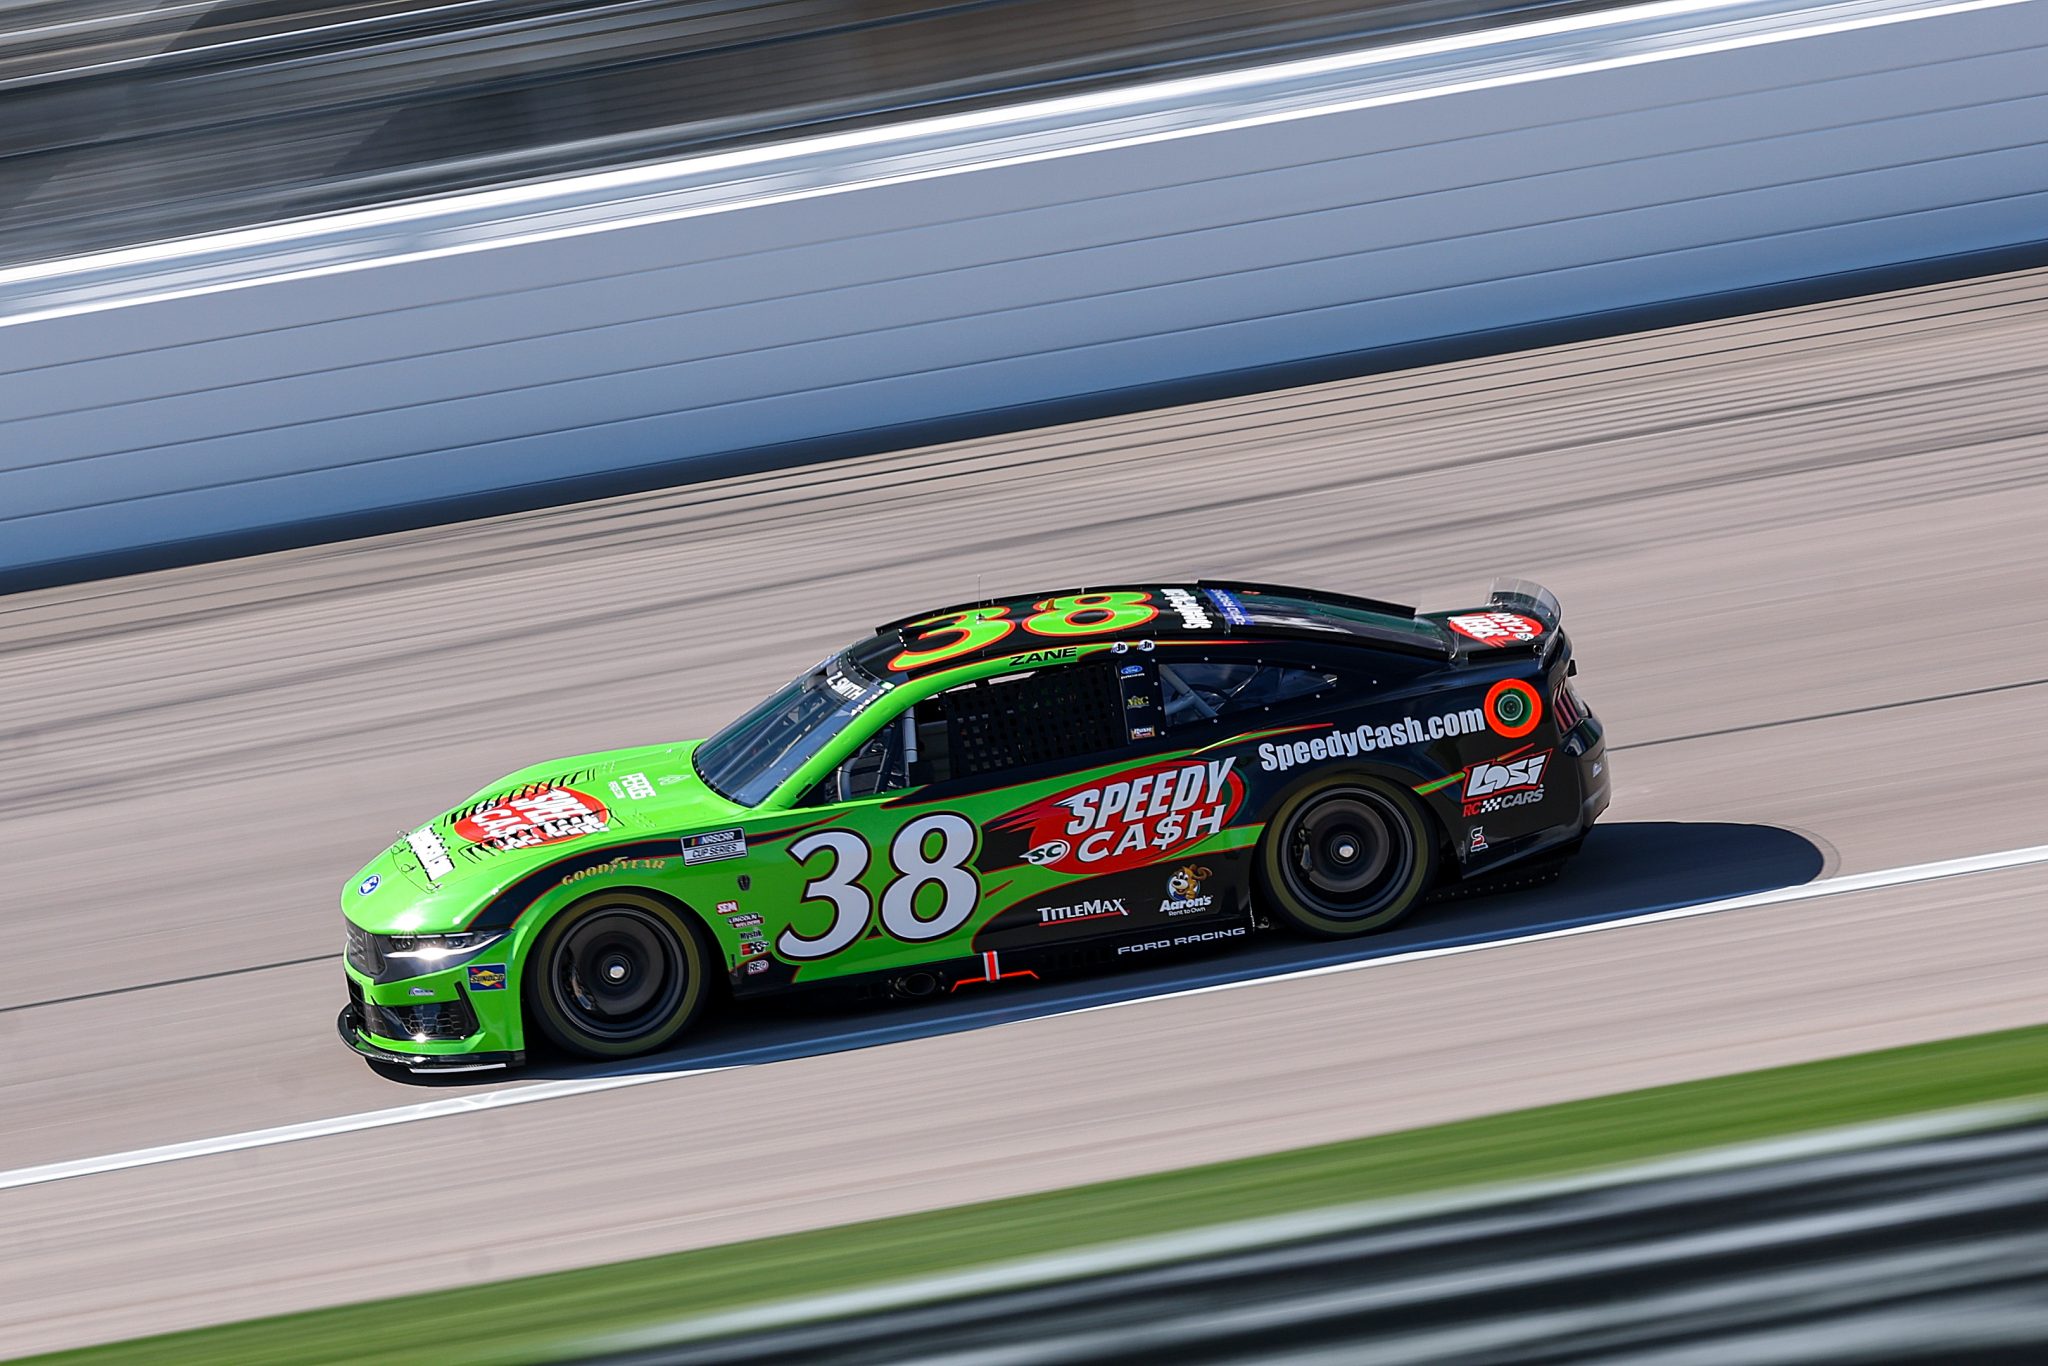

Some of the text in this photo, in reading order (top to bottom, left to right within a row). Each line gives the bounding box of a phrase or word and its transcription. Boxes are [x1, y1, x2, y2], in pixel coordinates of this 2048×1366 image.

[887, 591, 1159, 671] 38
[1009, 647, 1078, 666] ZANE
[1258, 708, 1485, 771] SpeedyCash.com
[1056, 757, 1236, 835] SPEEDY
[1463, 789, 1544, 817] RC CARS
[693, 843, 737, 857] CUP SERIES
[702, 831, 735, 844] NASCAR
[1031, 843, 1063, 862] SC
[562, 857, 666, 885] GOODYEAR
[776, 812, 980, 960] 38
[1159, 896, 1212, 913] Aaron's
[1117, 927, 1246, 955] FORD RACING
